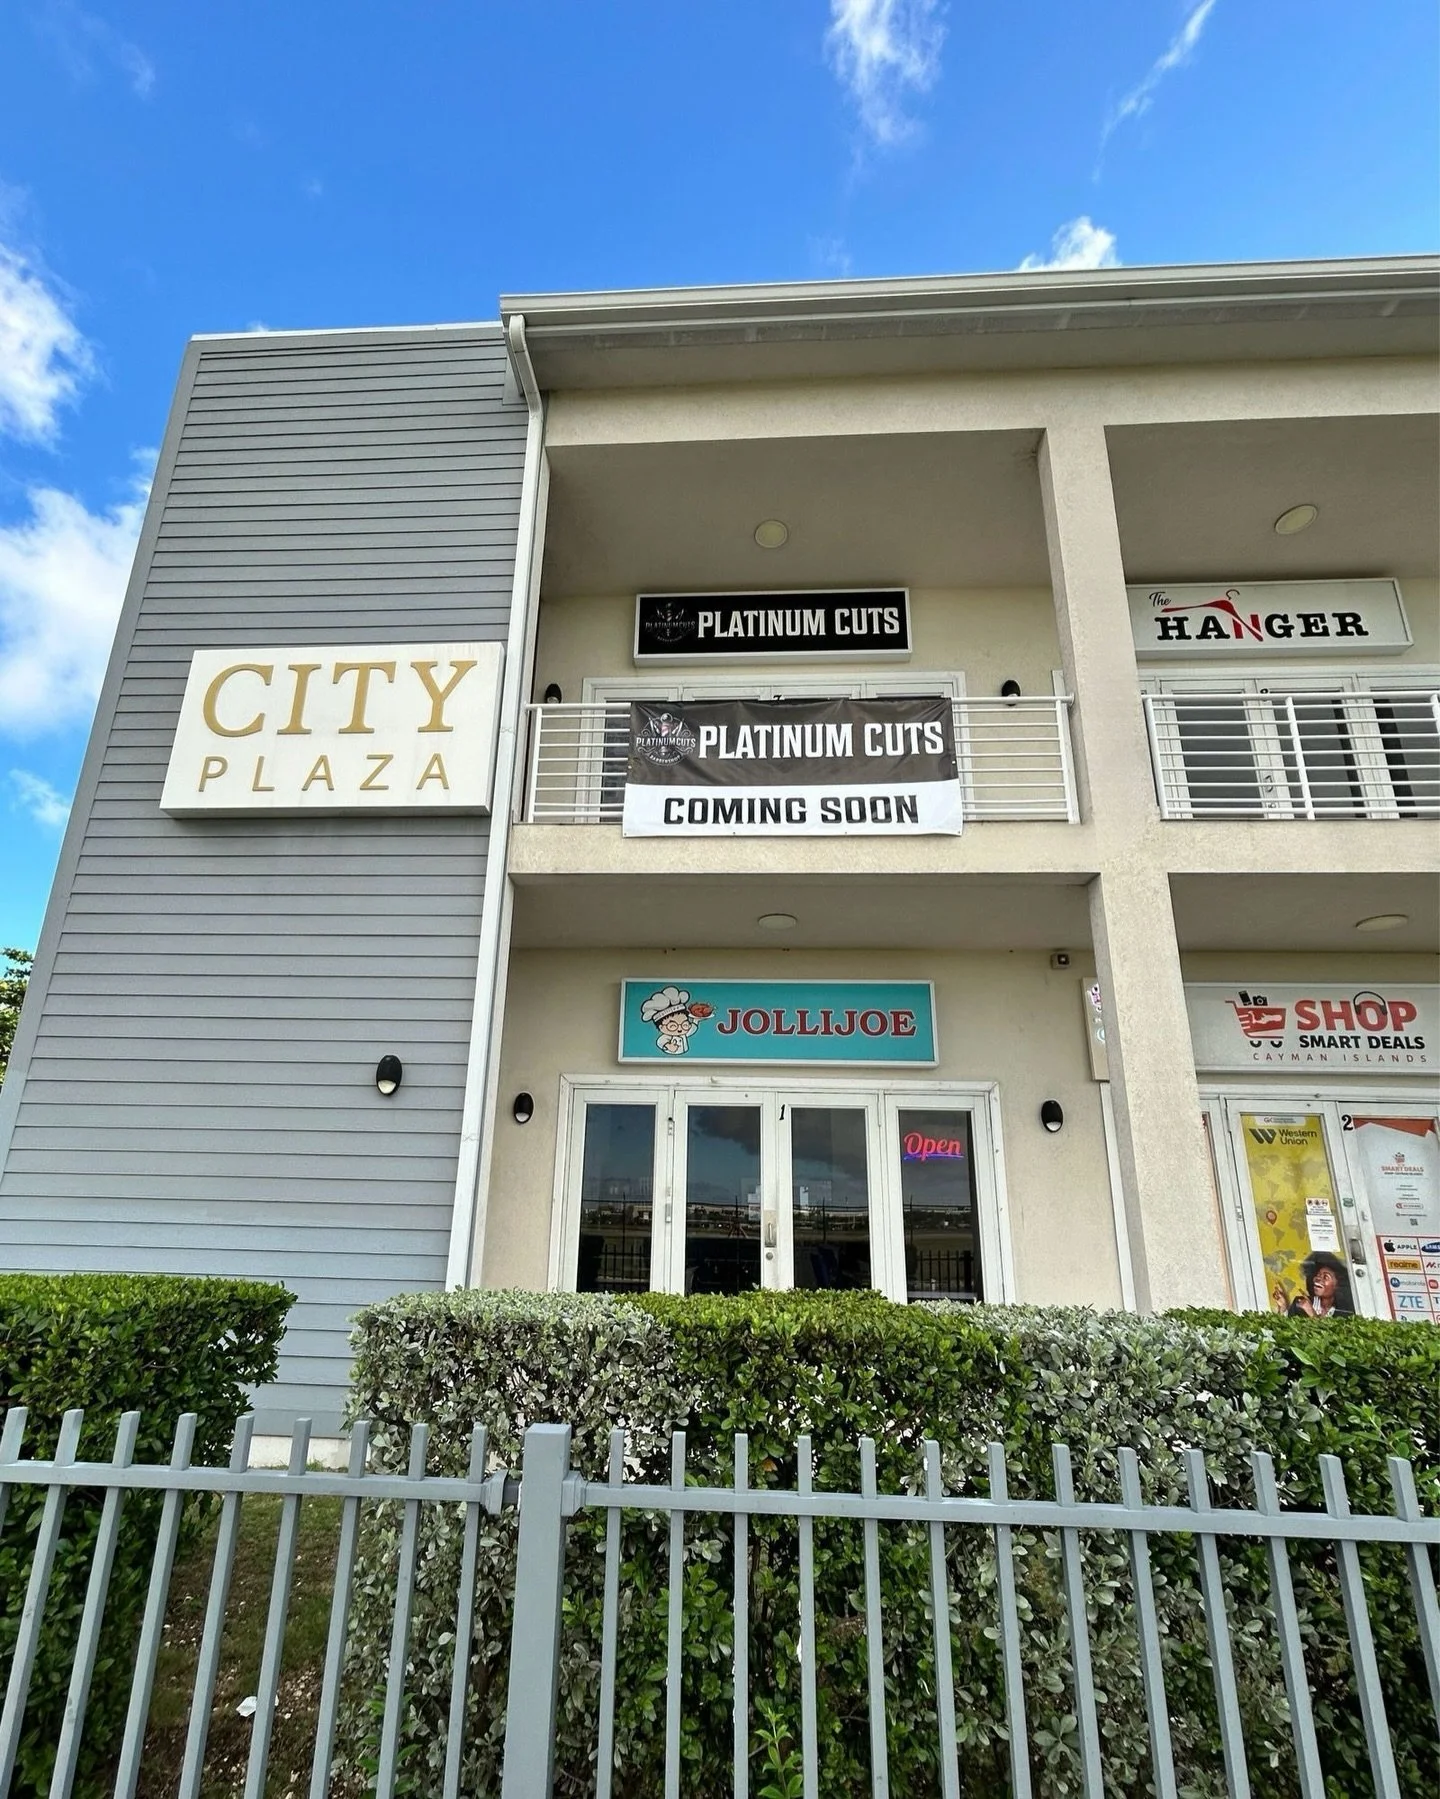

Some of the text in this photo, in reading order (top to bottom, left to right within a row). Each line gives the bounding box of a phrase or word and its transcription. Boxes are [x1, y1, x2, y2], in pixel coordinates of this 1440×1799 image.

[1149, 591, 1171, 607] The
[697, 607, 900, 638] PLATINUM CUTS
[1154, 612, 1369, 642] HANGER
[203, 660, 478, 737] CITY
[635, 737, 697, 748] PLATINUMCUTS
[698, 721, 944, 759] PLATINUM CUTS
[198, 753, 450, 792] PLAZA
[663, 795, 919, 825] COMING SOON
[717, 1008, 916, 1036] JOLLIJOE
[1294, 999, 1417, 1032] SHOP
[1299, 1035, 1426, 1050] SMART DEALS
[1252, 1052, 1427, 1063] CAYMAN ISLANDS
[779, 1104, 785, 1121] 1
[1341, 1114, 1354, 1131] 2
[1279, 1128, 1317, 1138] Western
[904, 1132, 961, 1161] Open
[1389, 1260, 1418, 1269] realme
[1399, 1296, 1424, 1309] ZTE
